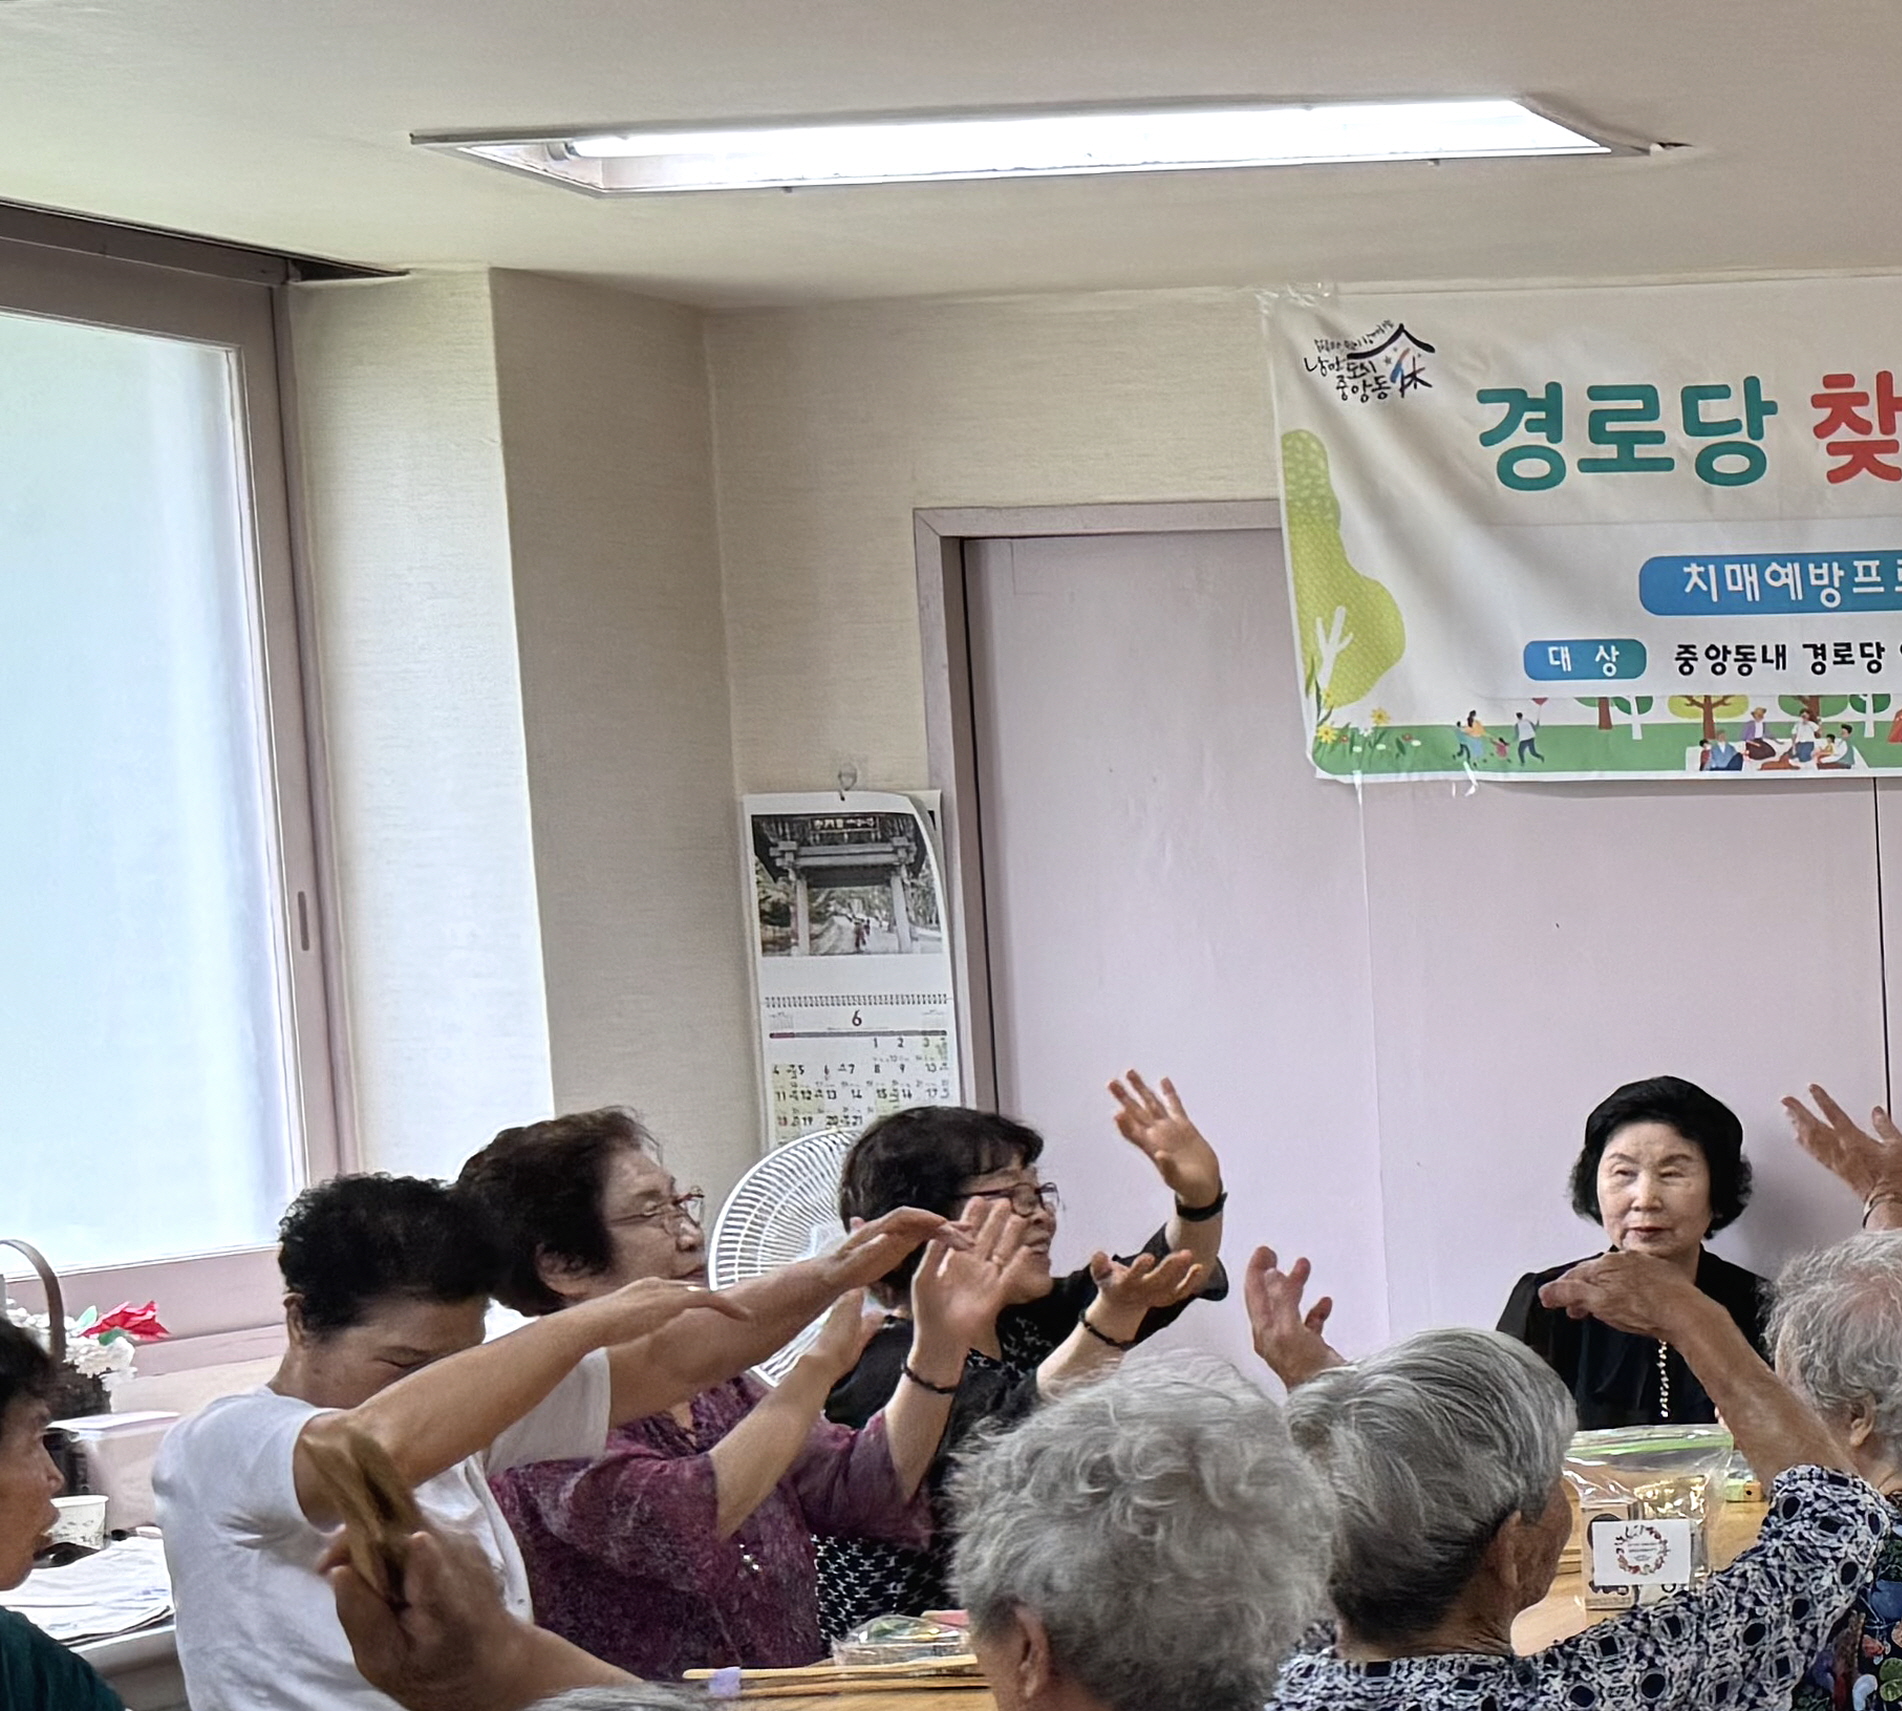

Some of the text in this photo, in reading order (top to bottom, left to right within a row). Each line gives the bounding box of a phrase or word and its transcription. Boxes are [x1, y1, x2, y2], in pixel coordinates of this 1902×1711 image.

[1336, 374, 1391, 403] 중앙동
[1478, 374, 1777, 490] 경로당
[1675, 644, 1786, 676] 중앙동내
[1802, 642, 1885, 675] 경로당
[852, 1010, 863, 1026] 6
